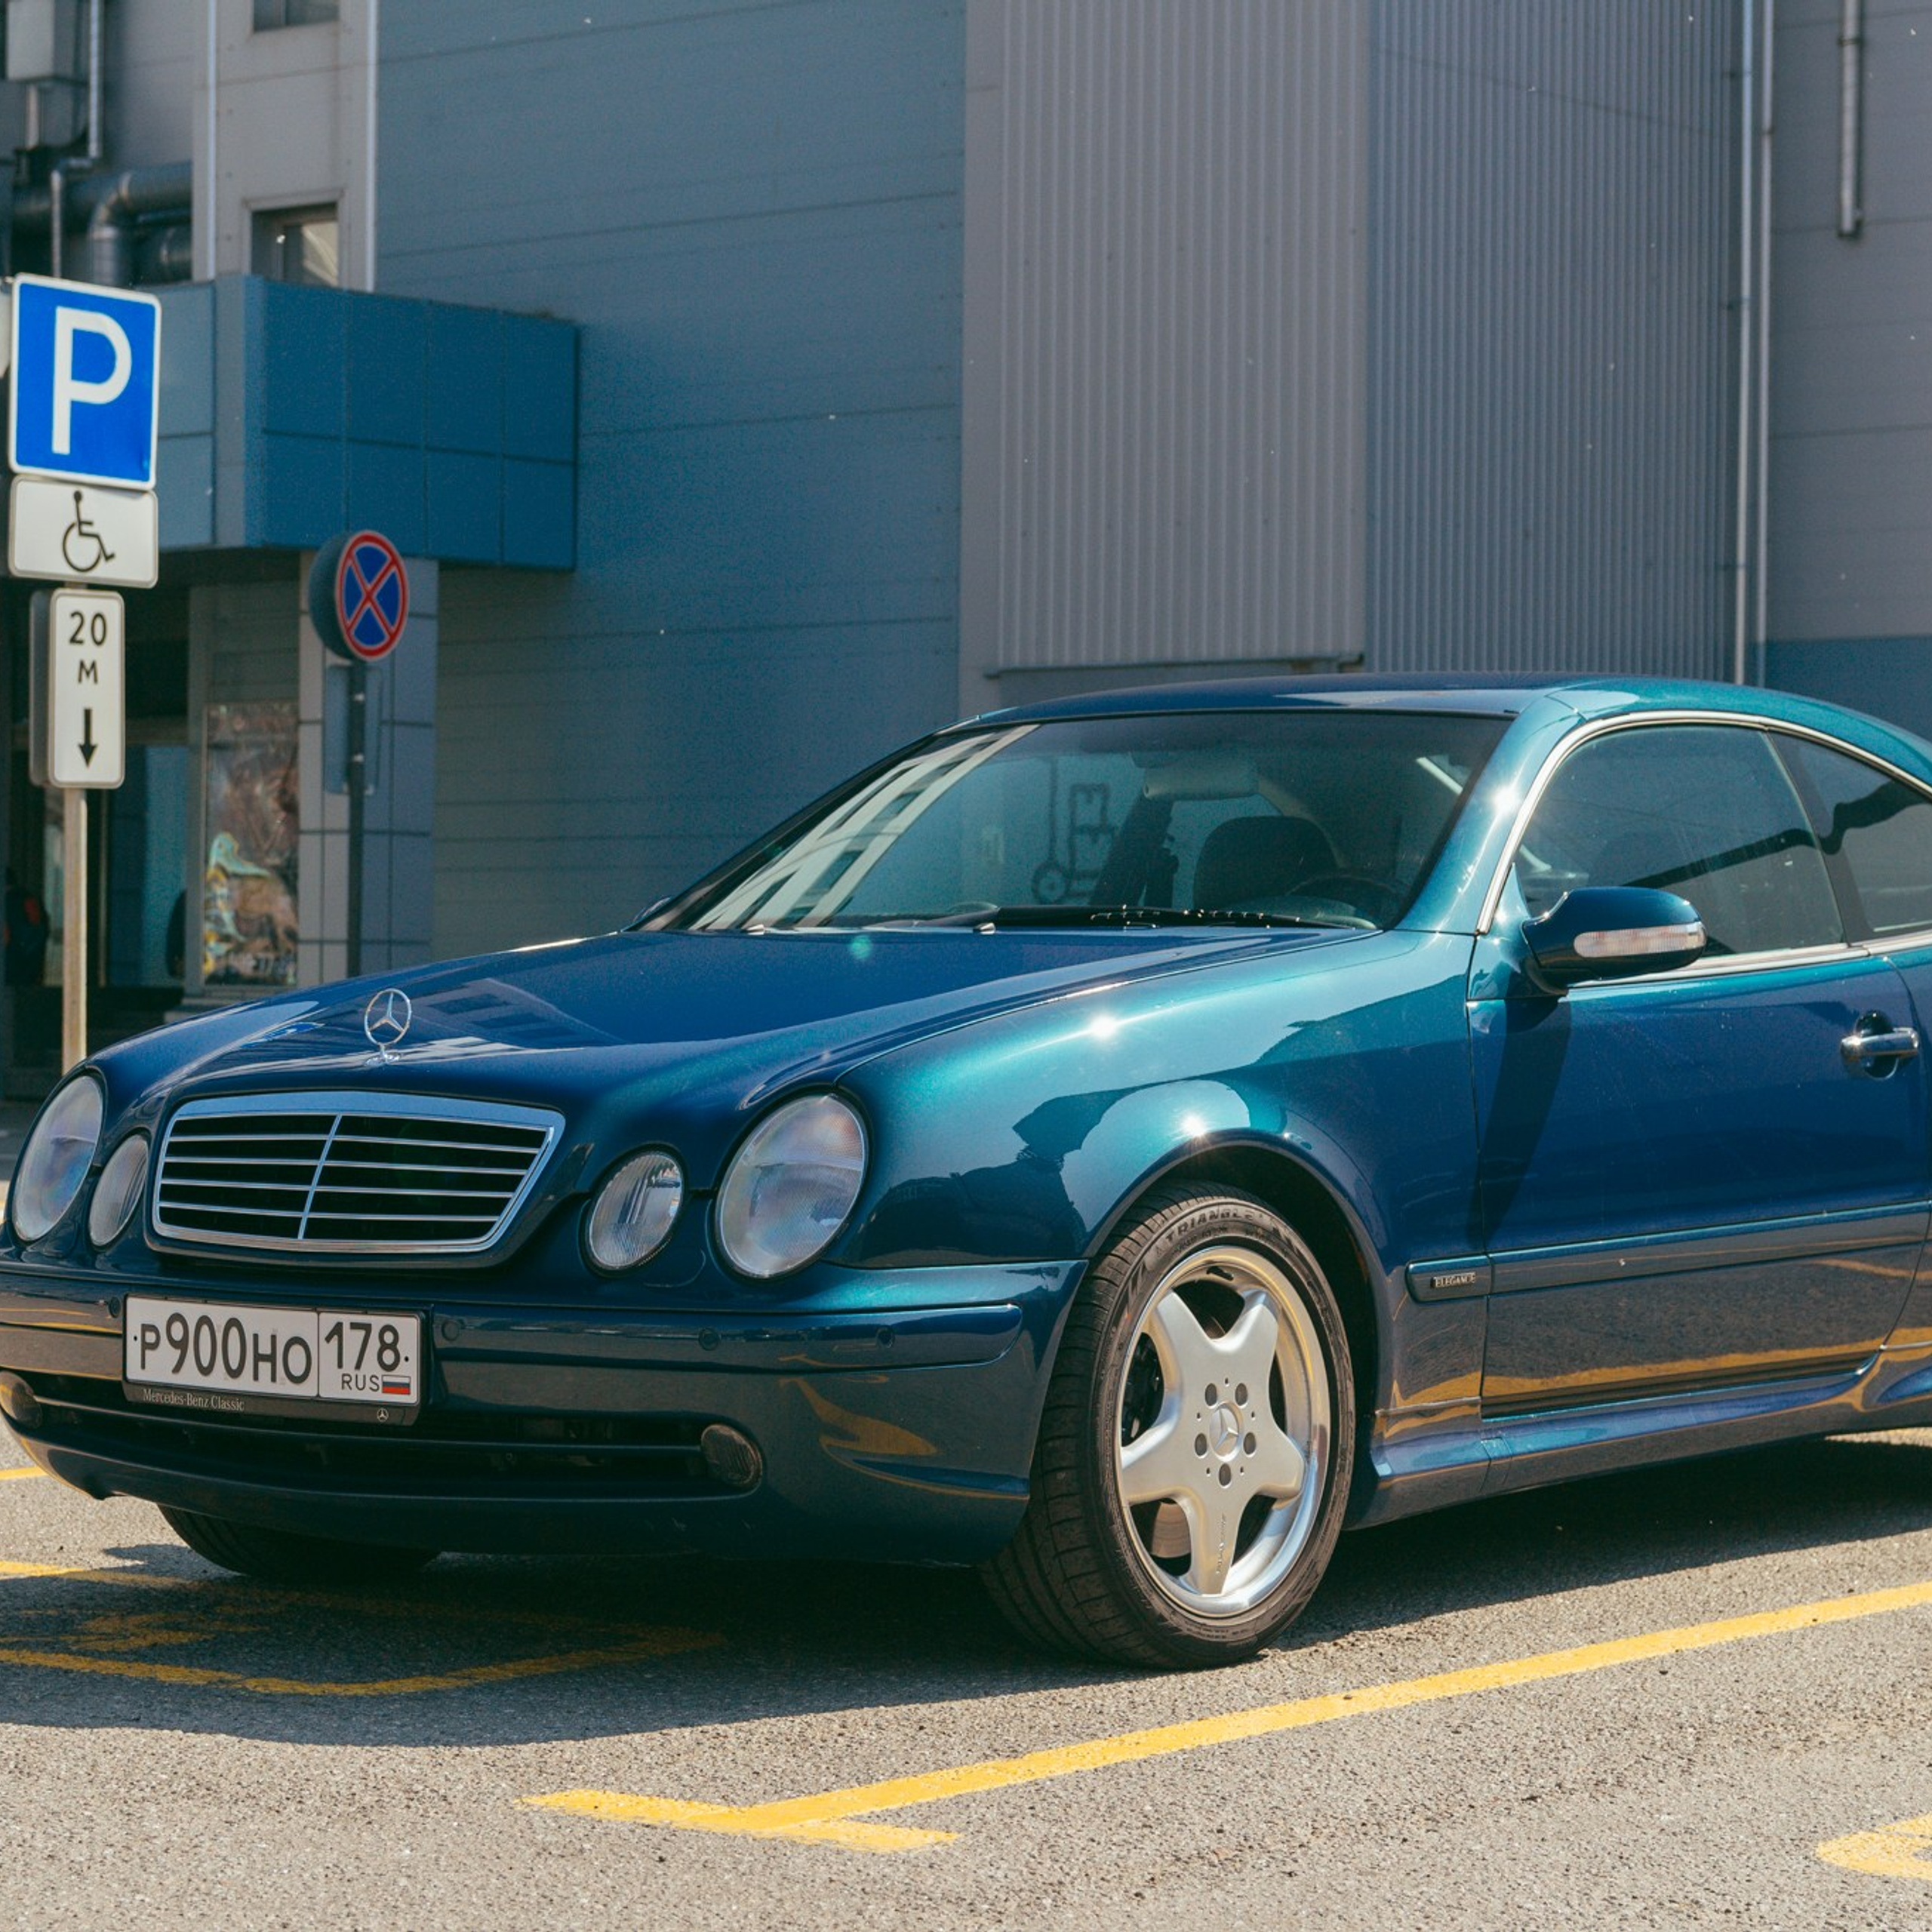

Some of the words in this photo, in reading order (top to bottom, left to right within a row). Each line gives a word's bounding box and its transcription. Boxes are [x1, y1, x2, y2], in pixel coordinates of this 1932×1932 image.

[51, 306, 133, 456] P
[69, 611, 108, 647] 20
[1165, 1208, 1255, 1244] TRIANGLE
[1433, 1271, 1477, 1288] ELEGANCE
[324, 1321, 401, 1373] 178
[143, 1388, 209, 1408] Mercedes-Benz
[211, 1395, 245, 1411] Classic
[340, 1372, 380, 1392] RUS
